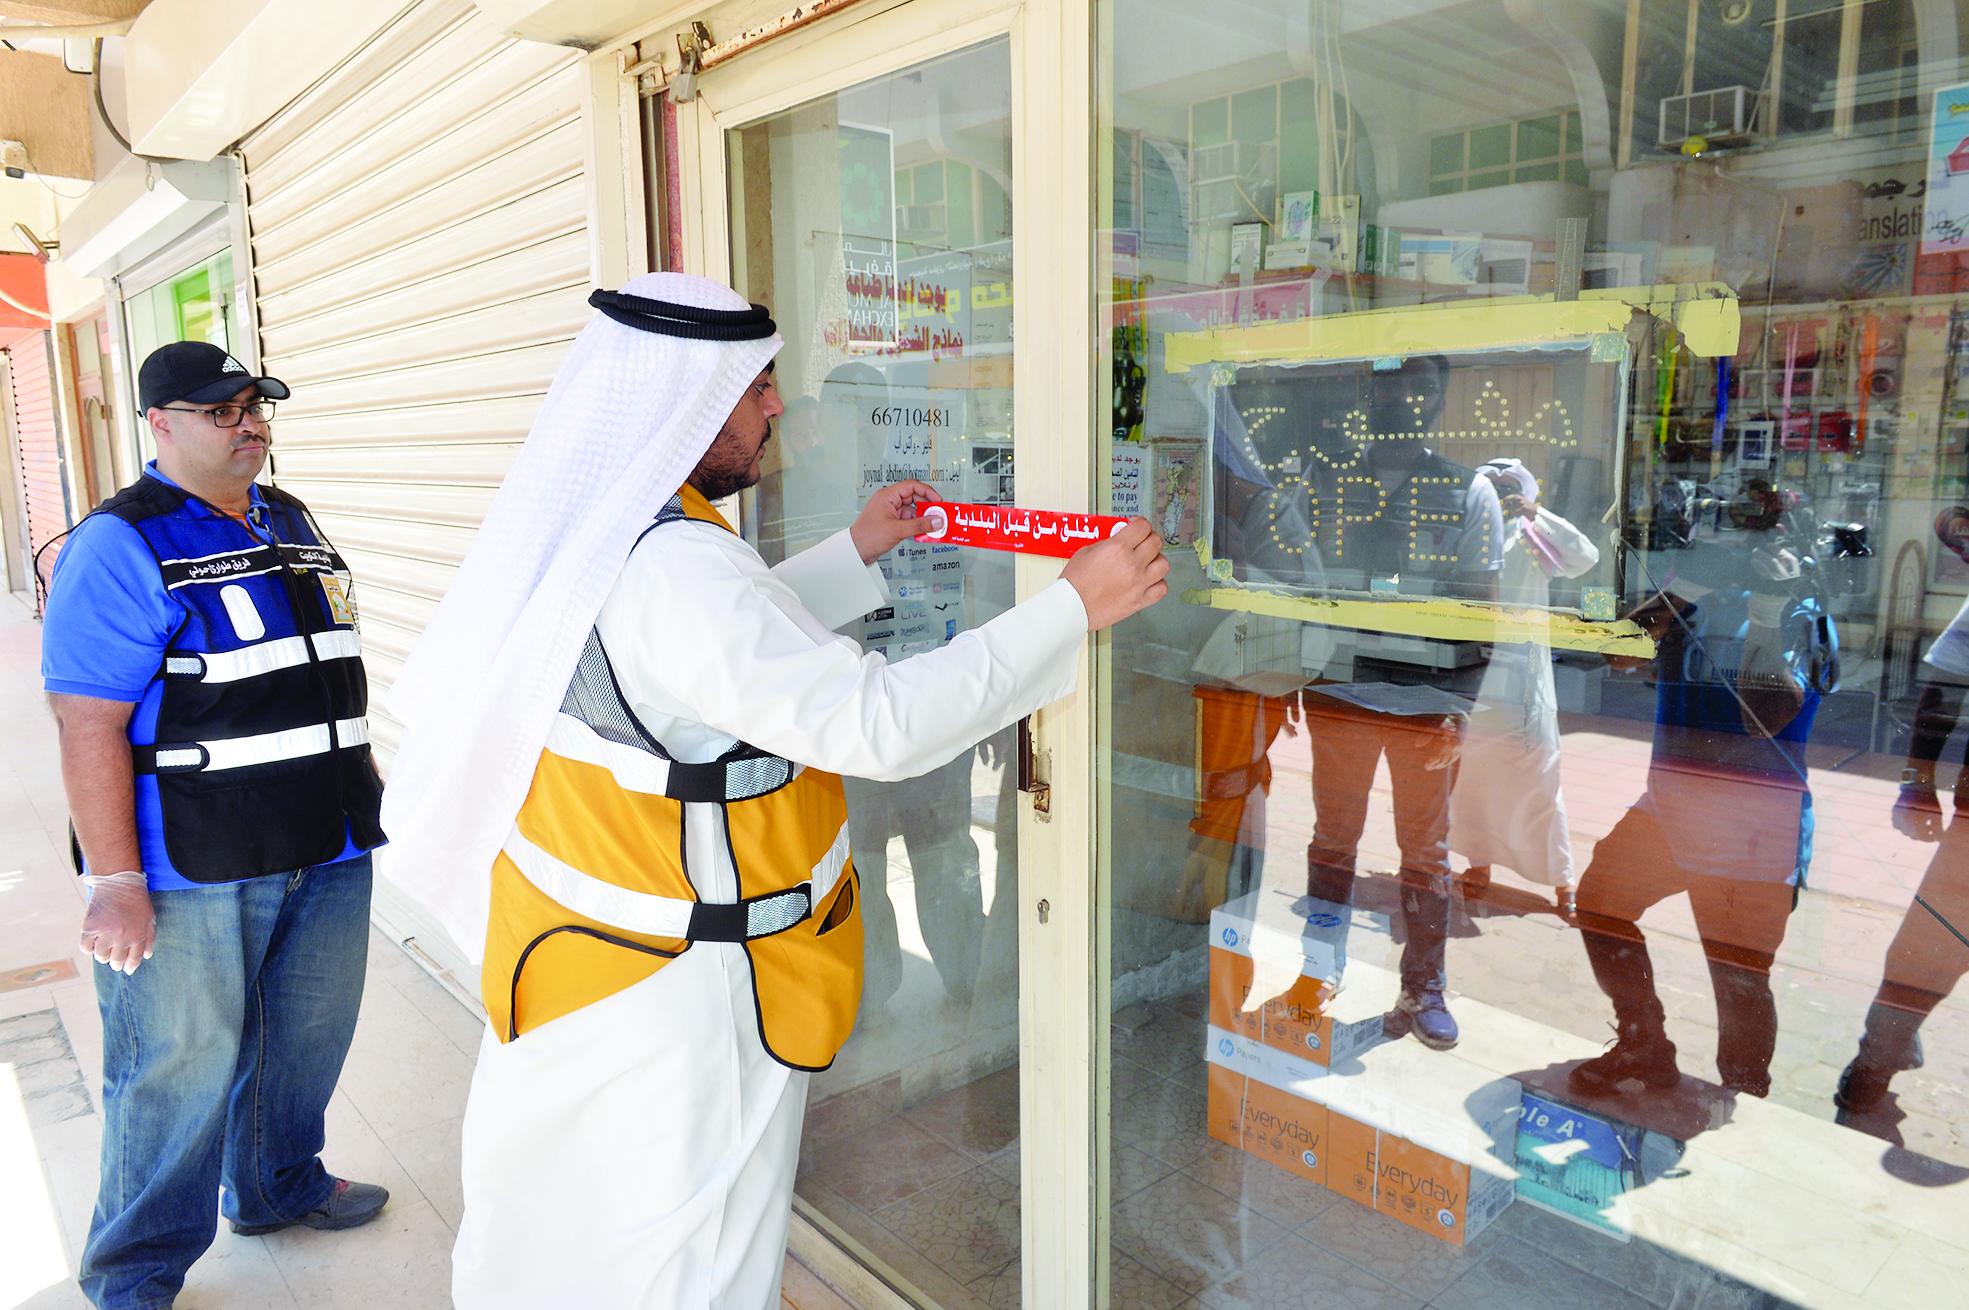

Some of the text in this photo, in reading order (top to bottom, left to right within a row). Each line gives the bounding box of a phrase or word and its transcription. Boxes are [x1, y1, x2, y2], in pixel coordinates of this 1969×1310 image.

[918, 282, 948, 314] يوجد
[933, 328, 963, 361] نماذج
[871, 407, 950, 427] 66710481
[1126, 504, 1139, 512] and
[954, 506, 1099, 543] مغلق من قبل البلدية
[906, 547, 927, 557] iTunes
[932, 546, 959, 554] facebook
[232, 558, 251, 571] فريق
[932, 561, 960, 572] amazon
[901, 610, 927, 620] LIVE
[904, 601, 923, 610] XBOX
[1223, 928, 1238, 947] hp
[1219, 1038, 1234, 1057] hp
[1240, 1098, 1319, 1150] Everyday
[1366, 1151, 1458, 1209] Everyday
